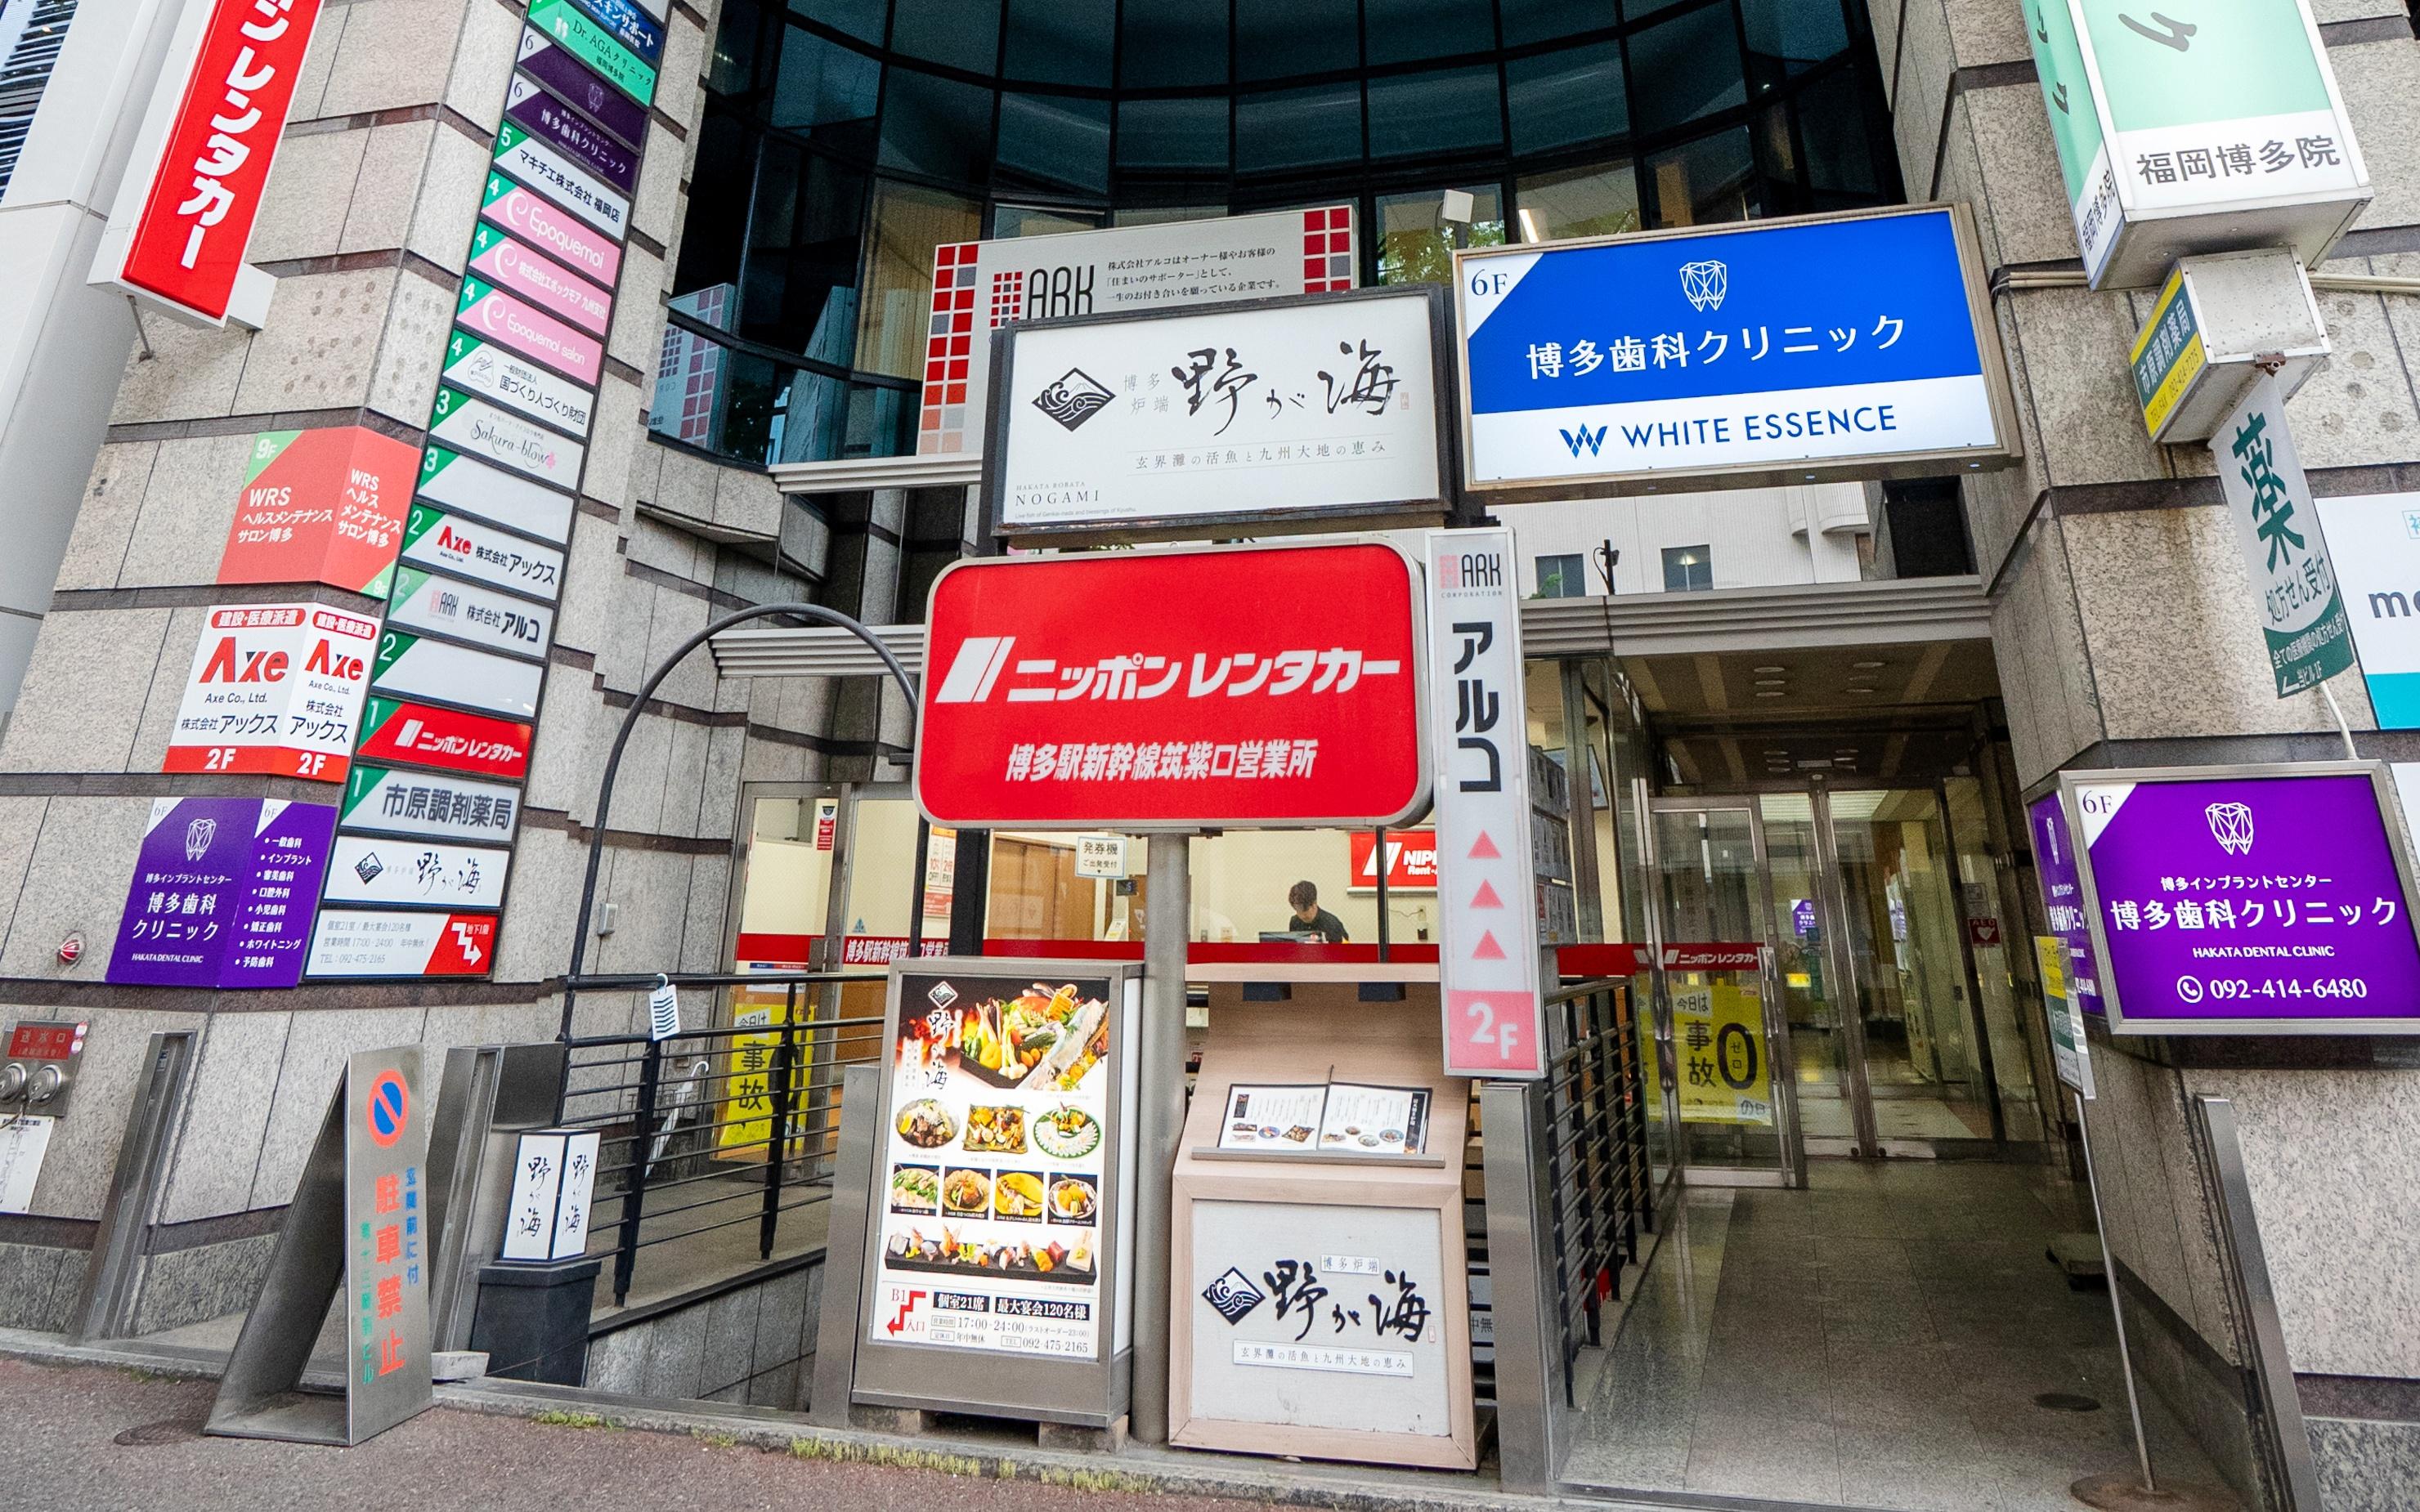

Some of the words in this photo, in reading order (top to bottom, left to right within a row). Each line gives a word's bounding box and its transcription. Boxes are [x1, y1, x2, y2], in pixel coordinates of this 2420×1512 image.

[572, 20, 589, 39] Dr.
[524, 34, 535, 51] 6
[513, 82, 523, 98] 6
[177, 0, 296, 270] ンレンタカー
[500, 127, 512, 147] 5
[540, 108, 627, 174] 博多歯科クリニック
[2135, 134, 2342, 186] 福岡博多院
[488, 178, 500, 197] 4
[594, 197, 621, 224] 福岡店
[477, 230, 488, 248] 4
[529, 207, 606, 270] Epoquemoi
[1107, 247, 1276, 272] 株式会社アルコはオーナー様やお客様の
[1105, 266, 1234, 288] 「住まいのサポーター」として、
[1470, 268, 1509, 297] 6F
[464, 282, 476, 302] 4
[1026, 265, 1095, 320] ARK
[1105, 278, 1281, 302] 一生のお付き合いを願っている企業です。
[450, 337, 463, 357] 4
[506, 313, 561, 353] Epoquemoi
[562, 344, 586, 366] salon
[1525, 314, 1907, 381] 博多歯科クリニック
[1170, 338, 1404, 437] 野が海
[435, 389, 450, 415] 3
[499, 374, 587, 426] 国づくり人づくり財団
[1620, 416, 1732, 448] WHITE
[1744, 404, 1898, 441] ESSENCE
[255, 438, 278, 459] 9F
[424, 449, 439, 472] 3
[1134, 439, 1387, 472] 玄界灘の活魚と九州大地の恵み
[350, 467, 380, 491] WRS
[249, 486, 292, 508] WRS
[346, 487, 379, 509] ヘルス
[1015, 490, 1100, 508] NOGAMI
[2230, 411, 2306, 575] 薬
[242, 508, 334, 526] ヘルスメンテナンス
[339, 503, 402, 535] メンテナンス
[409, 509, 424, 536] 2
[237, 526, 294, 544] サロン博多
[338, 520, 390, 548] サロン博多
[437, 526, 473, 556] Axe
[475, 545, 557, 586] 株式会社アックス
[1460, 552, 1502, 588] ARK
[373, 580, 388, 596] 9F
[394, 573, 410, 597] 2
[1440, 591, 1504, 599] CORPORATION
[2264, 549, 2333, 627] 処方せん受付
[438, 591, 459, 616] ARK
[217, 608, 299, 628] 建設・医療派遣
[466, 604, 541, 644] 株式会社アルコ
[198, 636, 289, 683] Axe
[304, 637, 365, 682] Axe
[379, 633, 397, 662] 2
[1006, 647, 1401, 703] ニッポンレンタカー
[204, 693, 225, 704] Axe
[227, 692, 246, 704] Co.,
[249, 692, 268, 703] Ltd.
[309, 679, 323, 689] Axe
[337, 686, 351, 696] Ltd.
[306, 700, 344, 718] 株式会社
[370, 700, 379, 728] 1
[1452, 620, 1503, 793] アルコ
[181, 713, 279, 735] 株式会社アックス
[289, 715, 349, 744] アックス
[417, 731, 523, 763] ニッポンレンタカー
[204, 748, 237, 772] 2F
[296, 752, 327, 776] 2F
[1004, 738, 1320, 783] 博多駅新幹線筑紫口営業所
[353, 769, 364, 798] 1
[153, 805, 168, 817] 6F
[264, 804, 278, 819] 6F
[382, 783, 513, 831] 市原調剤薬局
[2082, 789, 2114, 816] 6F
[271, 835, 302, 849] 一般歯科
[1082, 842, 1119, 857] 発券機
[267, 853, 312, 866] インプラント
[1082, 859, 1118, 870] ご出発受付
[145, 873, 233, 885] 博多インプラントセンター
[416, 852, 482, 897] 野が海
[2159, 874, 2333, 892] 博多インプラントセンター
[146, 891, 217, 916] 博多歯科
[254, 903, 287, 916] 小児歯科
[2109, 897, 2397, 932] 博多歯科クリニック
[132, 919, 219, 942] クリニック
[1971, 919, 1996, 927] AED
[245, 938, 302, 951] ホワイトニング
[2192, 946, 2243, 959] HAKATA
[2243, 946, 2292, 958] DENTAL
[2292, 945, 2336, 958] CLINIC
[131, 953, 159, 963] HAKATA
[157, 953, 182, 963] DENTAL
[182, 954, 204, 964] CLINIC
[242, 955, 275, 968] 予防歯科
[1678, 952, 1759, 964] ニッポンレンタカー
[1677, 989, 1710, 1012] 今日は
[2209, 977, 2368, 1000] 092-414-6480
[1466, 1001, 1519, 1060] 2F
[1683, 1020, 1717, 1088] 事故
[1717, 1022, 1758, 1090] 0
[1730, 1040, 1742, 1070] ゼロ
[737, 1040, 767, 1112] 事故
[1740, 1099, 1767, 1116] の日
[375, 1173, 406, 1377] 駐車禁止
[891, 1288, 907, 1303] B1
[937, 1293, 985, 1311] 個室21席
[1263, 1259, 1432, 1343] 野が海
[997, 1296, 1087, 1321] 最大宴会120名様
[906, 1320, 925, 1333] 入口
[1022, 1337, 1089, 1353] 092-475-2165
[1240, 1346, 1407, 1371] 玄界灘の活魚と九州大地の恵み
